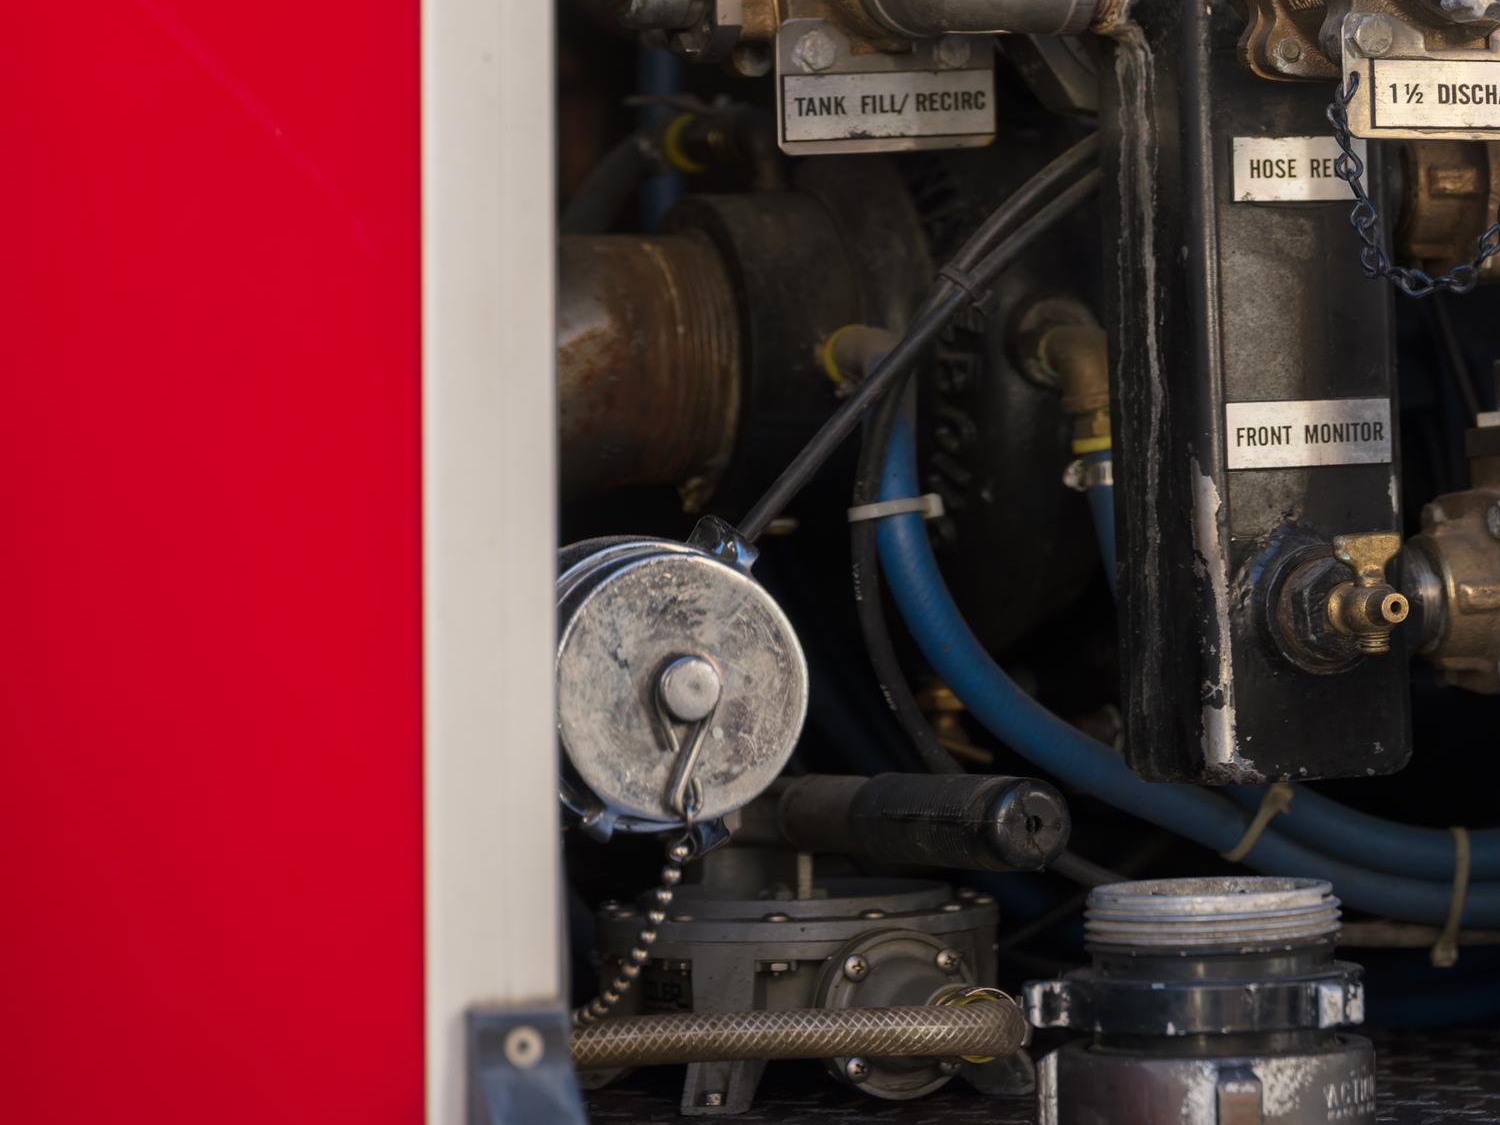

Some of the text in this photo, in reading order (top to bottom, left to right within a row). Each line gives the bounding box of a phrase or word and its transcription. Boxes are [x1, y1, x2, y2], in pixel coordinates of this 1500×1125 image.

[794, 90, 986, 117] TANK FILL/ RECIRC
[1249, 157, 1298, 180] HOSE
[1236, 421, 1385, 447] FRONT MONITOR
